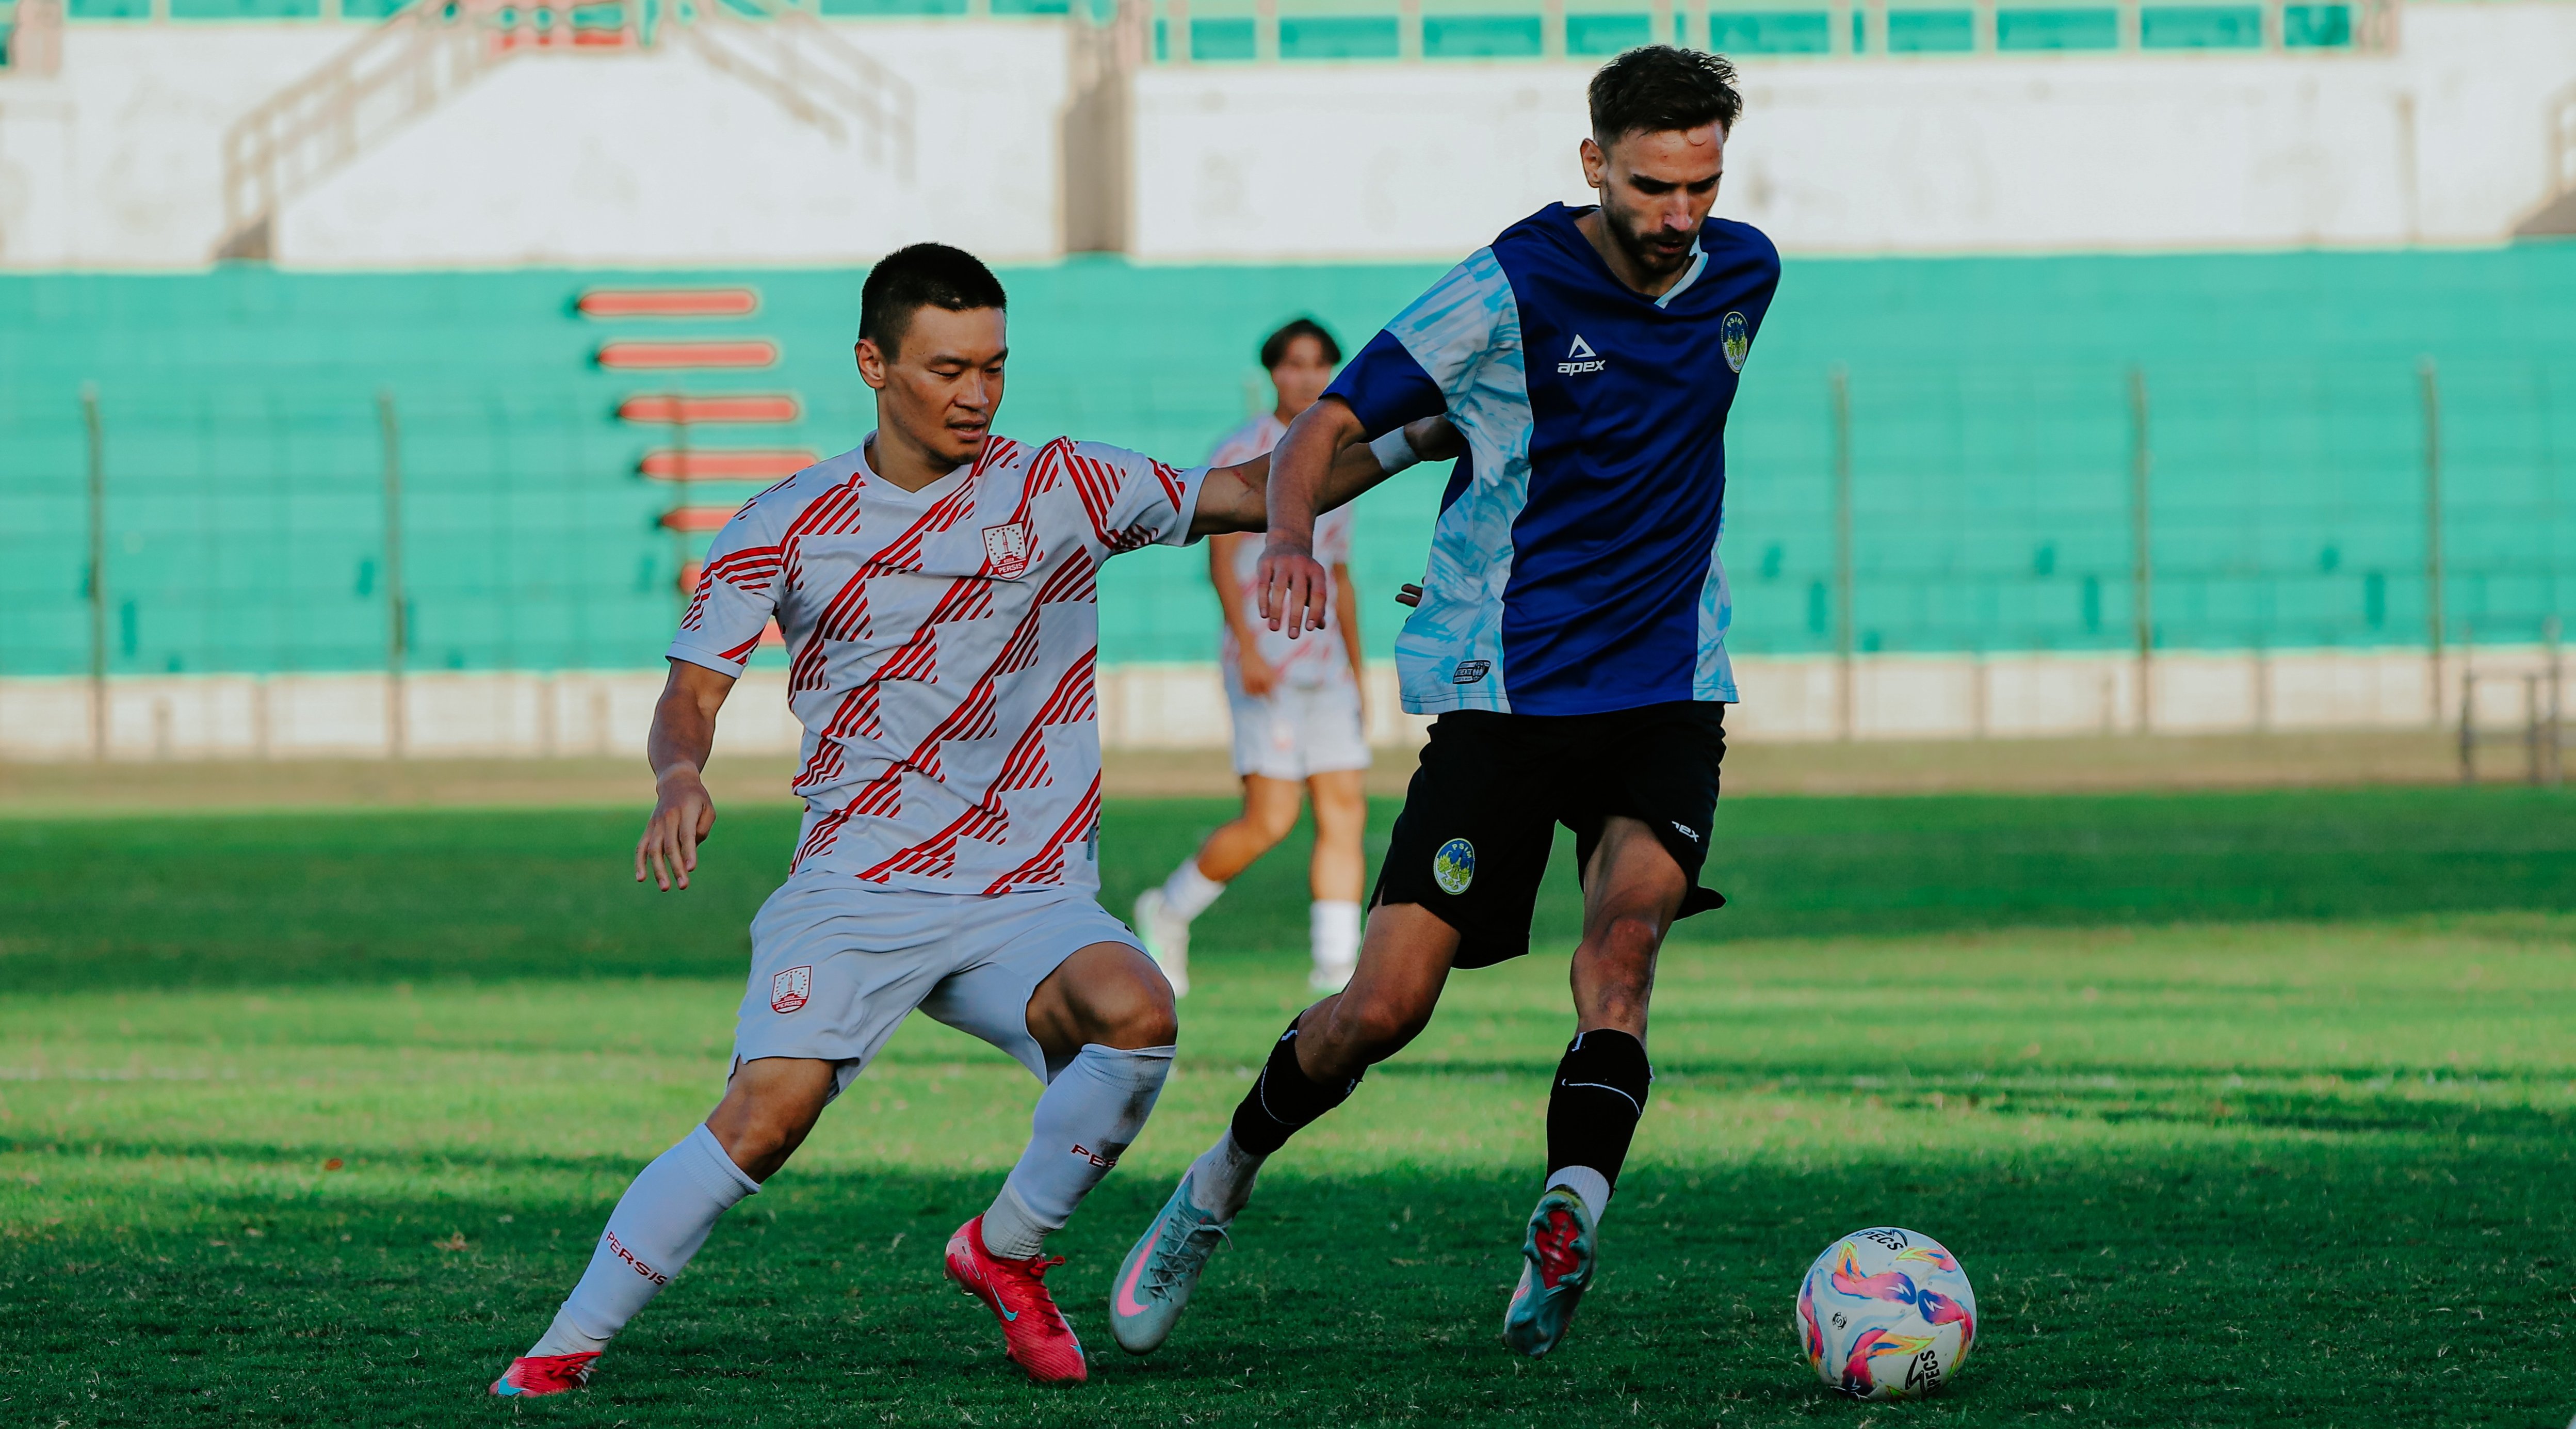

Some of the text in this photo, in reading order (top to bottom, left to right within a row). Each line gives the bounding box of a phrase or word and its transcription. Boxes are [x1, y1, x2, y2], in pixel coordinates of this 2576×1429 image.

[1727, 317, 1743, 328] PSIM
[1557, 360, 1606, 376] apex
[998, 563, 1024, 573] PERSIS
[1452, 843, 1472, 858] PSIM
[775, 1000, 803, 1009] PERSIS
[606, 1231, 668, 1285] PERSIS
[1920, 1350, 1941, 1392] SPECS
